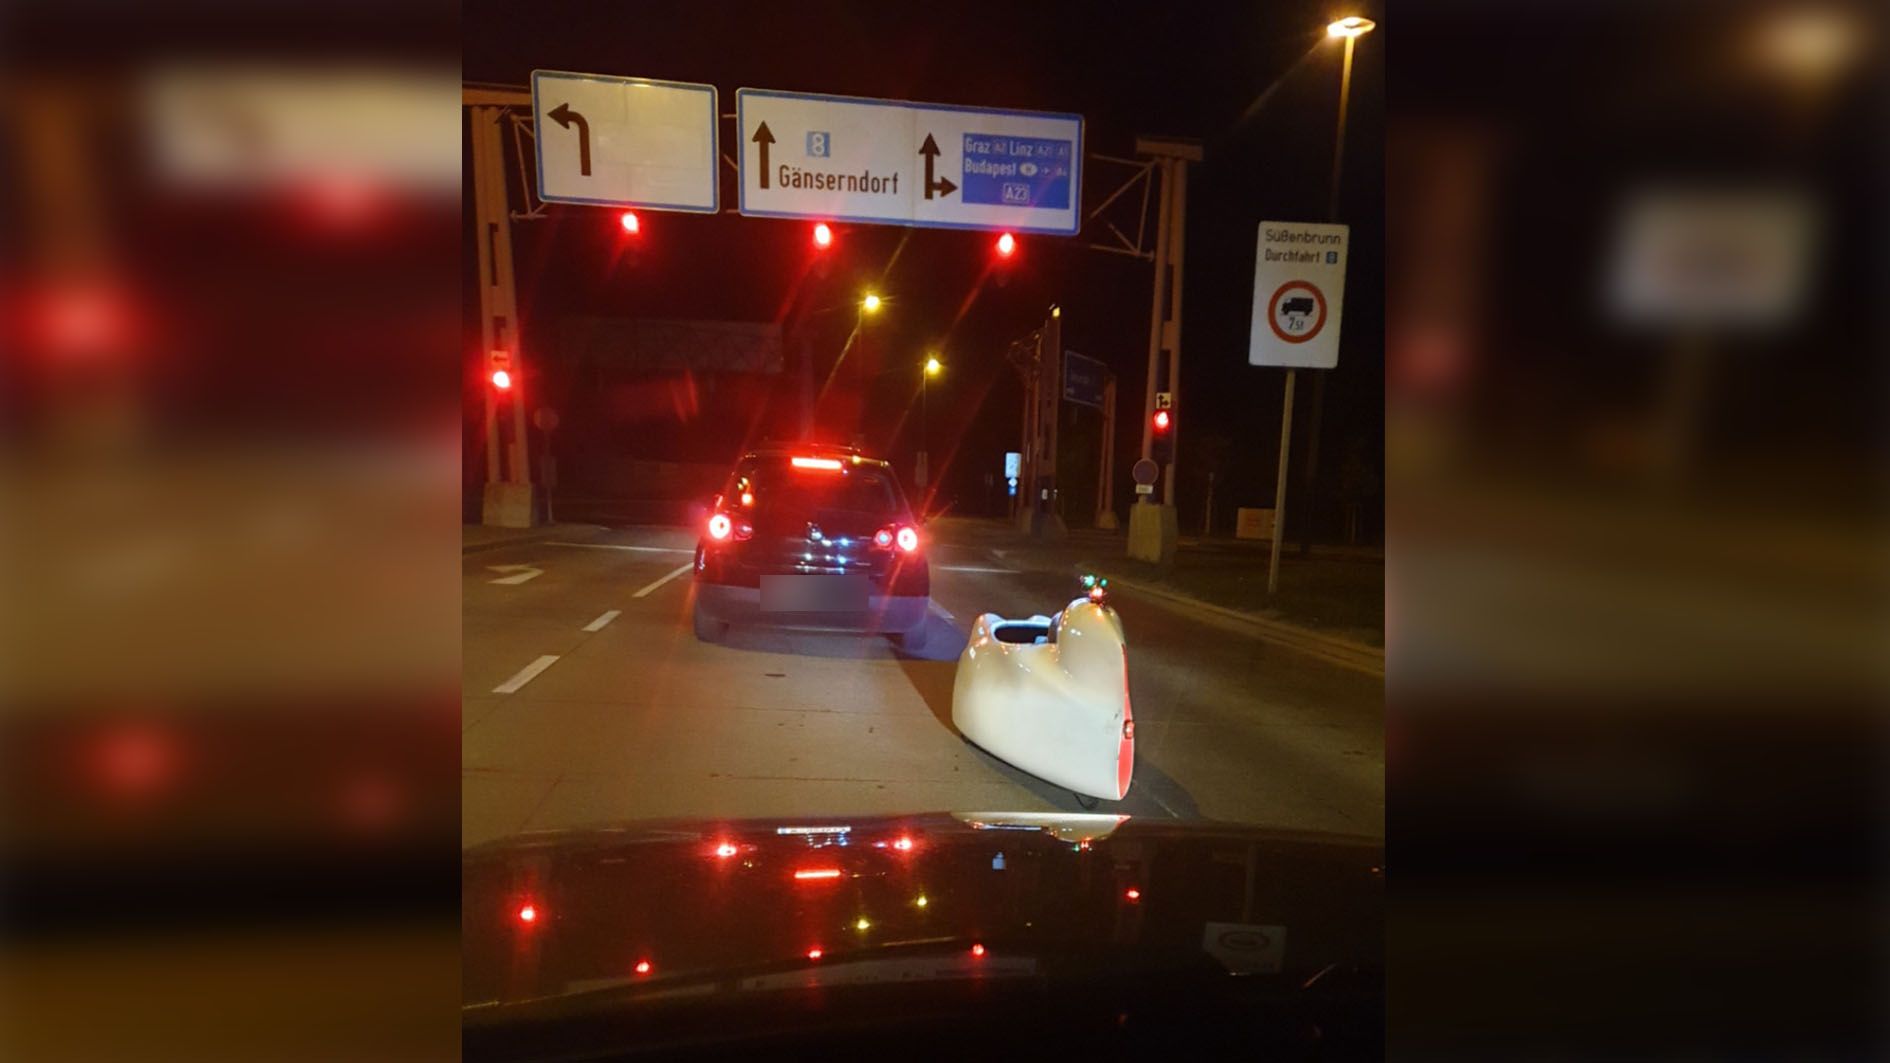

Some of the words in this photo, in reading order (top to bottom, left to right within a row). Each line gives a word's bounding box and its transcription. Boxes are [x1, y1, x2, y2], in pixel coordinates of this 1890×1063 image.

[811, 132, 826, 157] 8
[965, 138, 991, 155] Graz
[1009, 140, 1033, 156] Linz
[965, 158, 1016, 178] Budapest
[778, 164, 899, 195] Gänserndorf
[1005, 187, 1028, 201] A23
[1264, 248, 1320, 263] Durchfahrt
